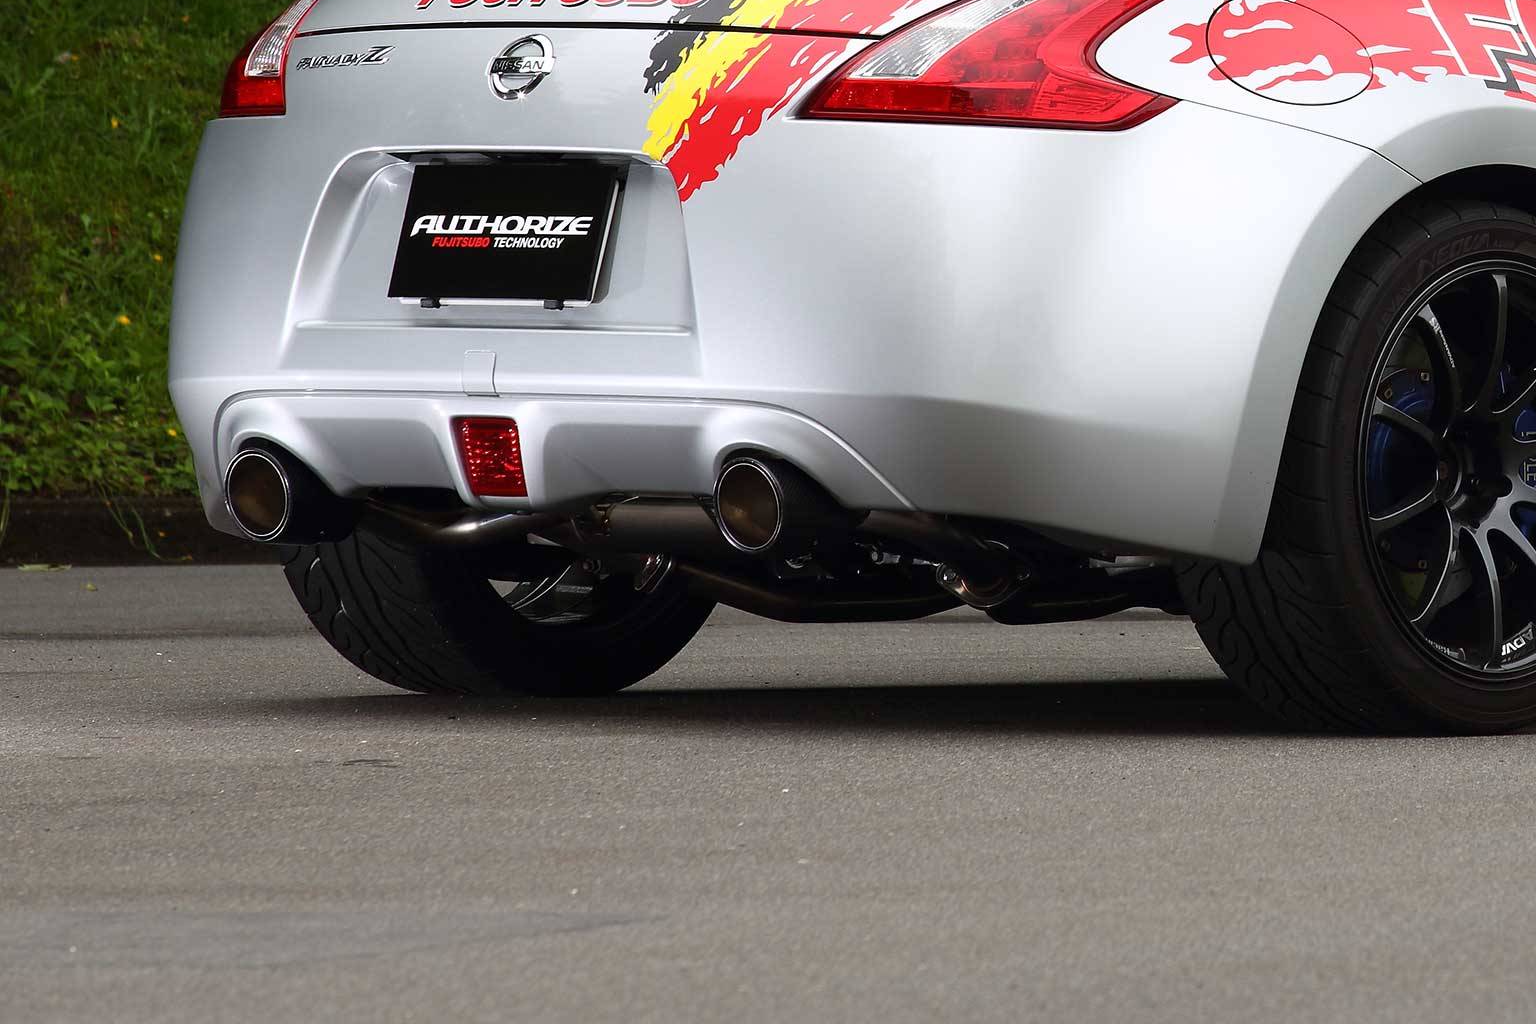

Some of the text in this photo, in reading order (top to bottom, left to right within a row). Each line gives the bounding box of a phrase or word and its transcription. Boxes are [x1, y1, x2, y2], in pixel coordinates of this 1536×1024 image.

[492, 60, 545, 72] NISSAN
[410, 215, 594, 237] AUTHORIZE
[431, 236, 565, 249] FUJITSUBO TECHNOLOGY
